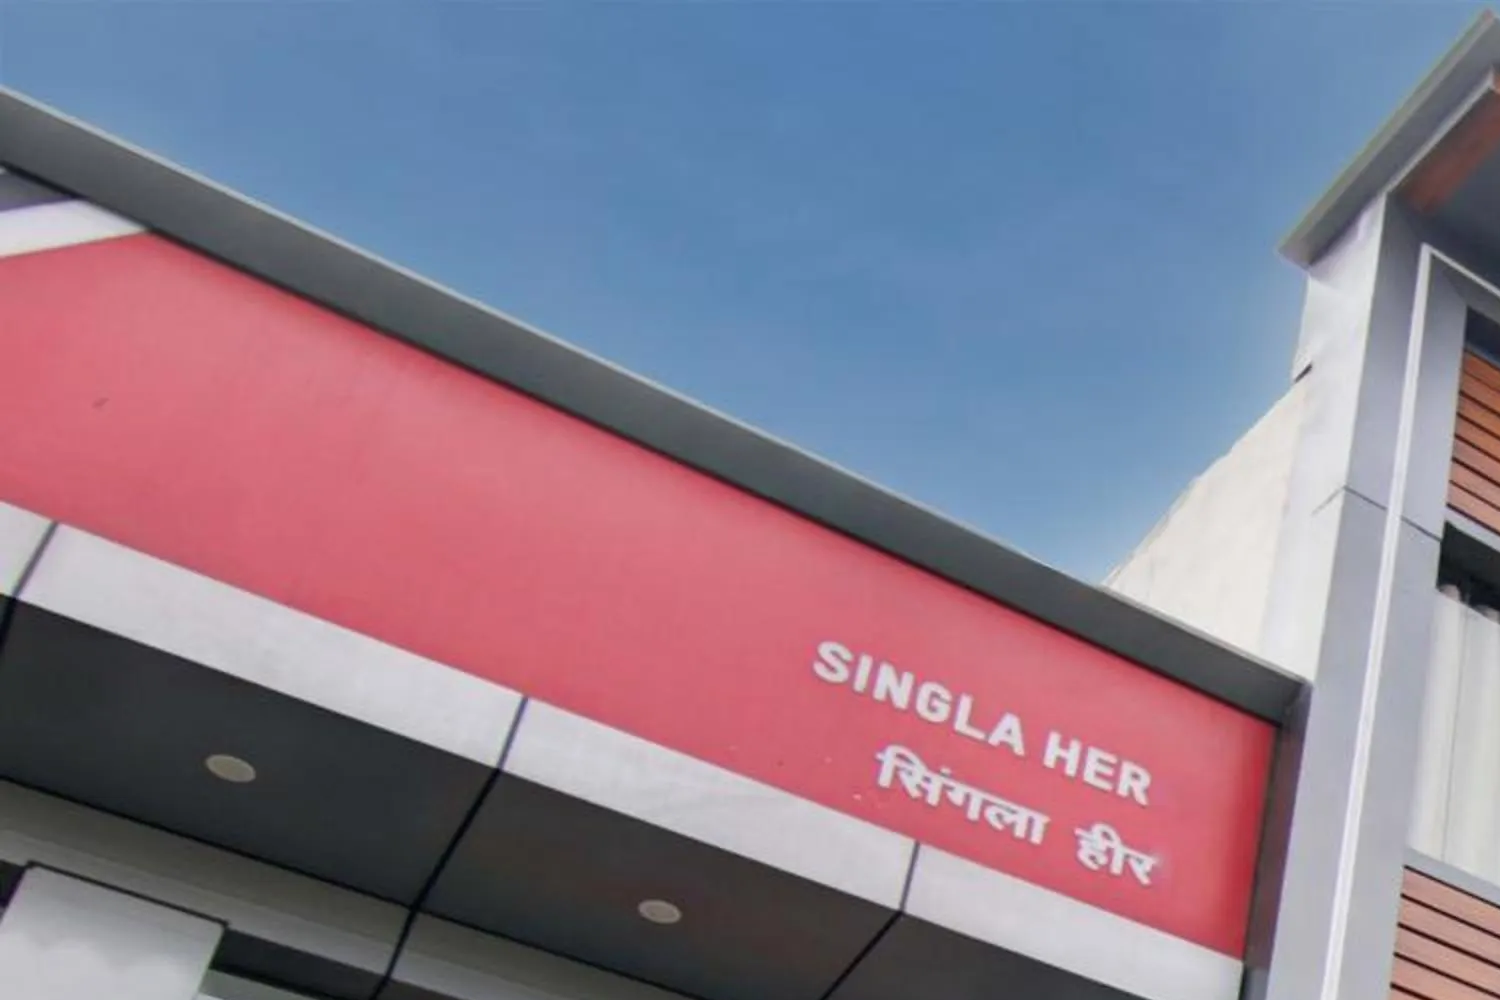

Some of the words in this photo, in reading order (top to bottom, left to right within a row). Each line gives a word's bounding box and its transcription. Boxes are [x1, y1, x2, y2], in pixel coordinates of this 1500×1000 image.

[813, 641, 1025, 756] SINGLA
[1043, 731, 1152, 805] HER
[875, 744, 1051, 845] सिंगला
